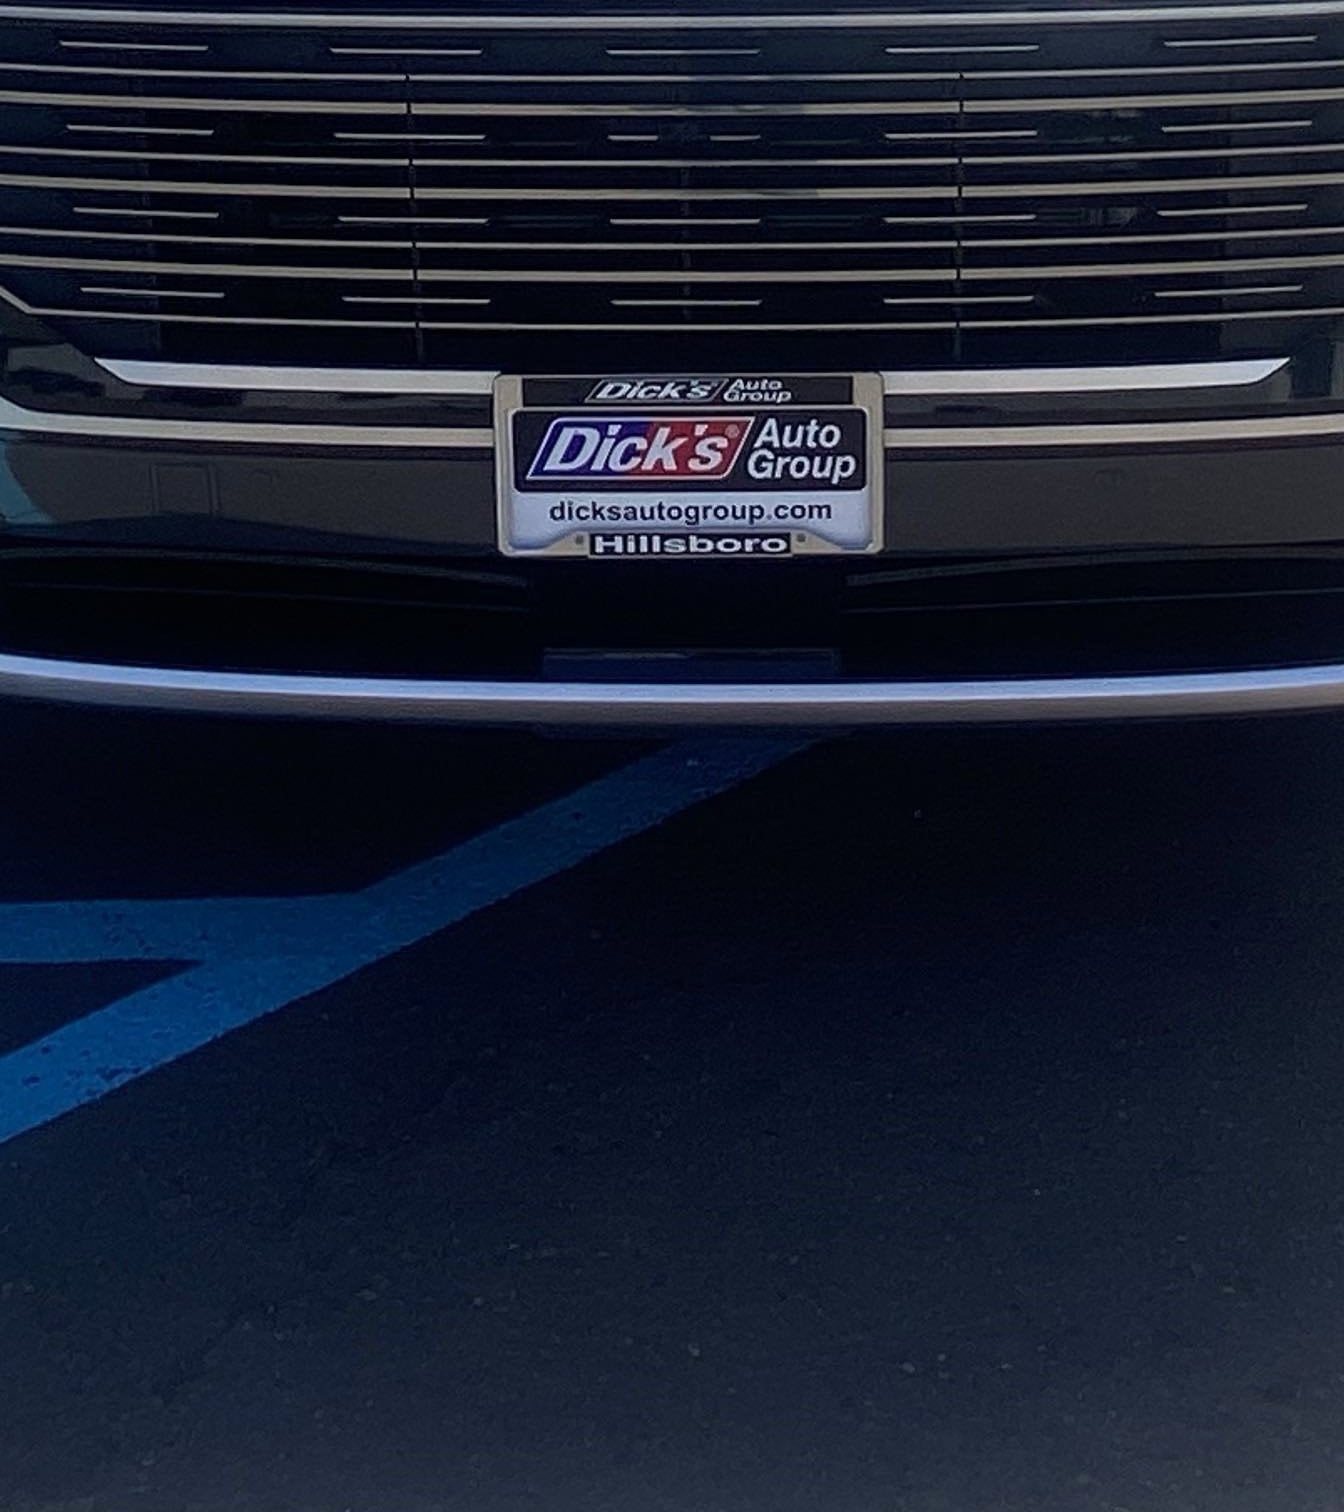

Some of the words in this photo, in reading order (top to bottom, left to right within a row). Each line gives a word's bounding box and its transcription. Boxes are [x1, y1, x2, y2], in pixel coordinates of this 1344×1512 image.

[731, 378, 782, 391] Auto
[723, 389, 792, 404] Group
[753, 418, 841, 449] Auto
[747, 449, 857, 484] Group
[550, 502, 832, 526] dicksautogroup.com
[594, 535, 789, 554] Hillsboro
